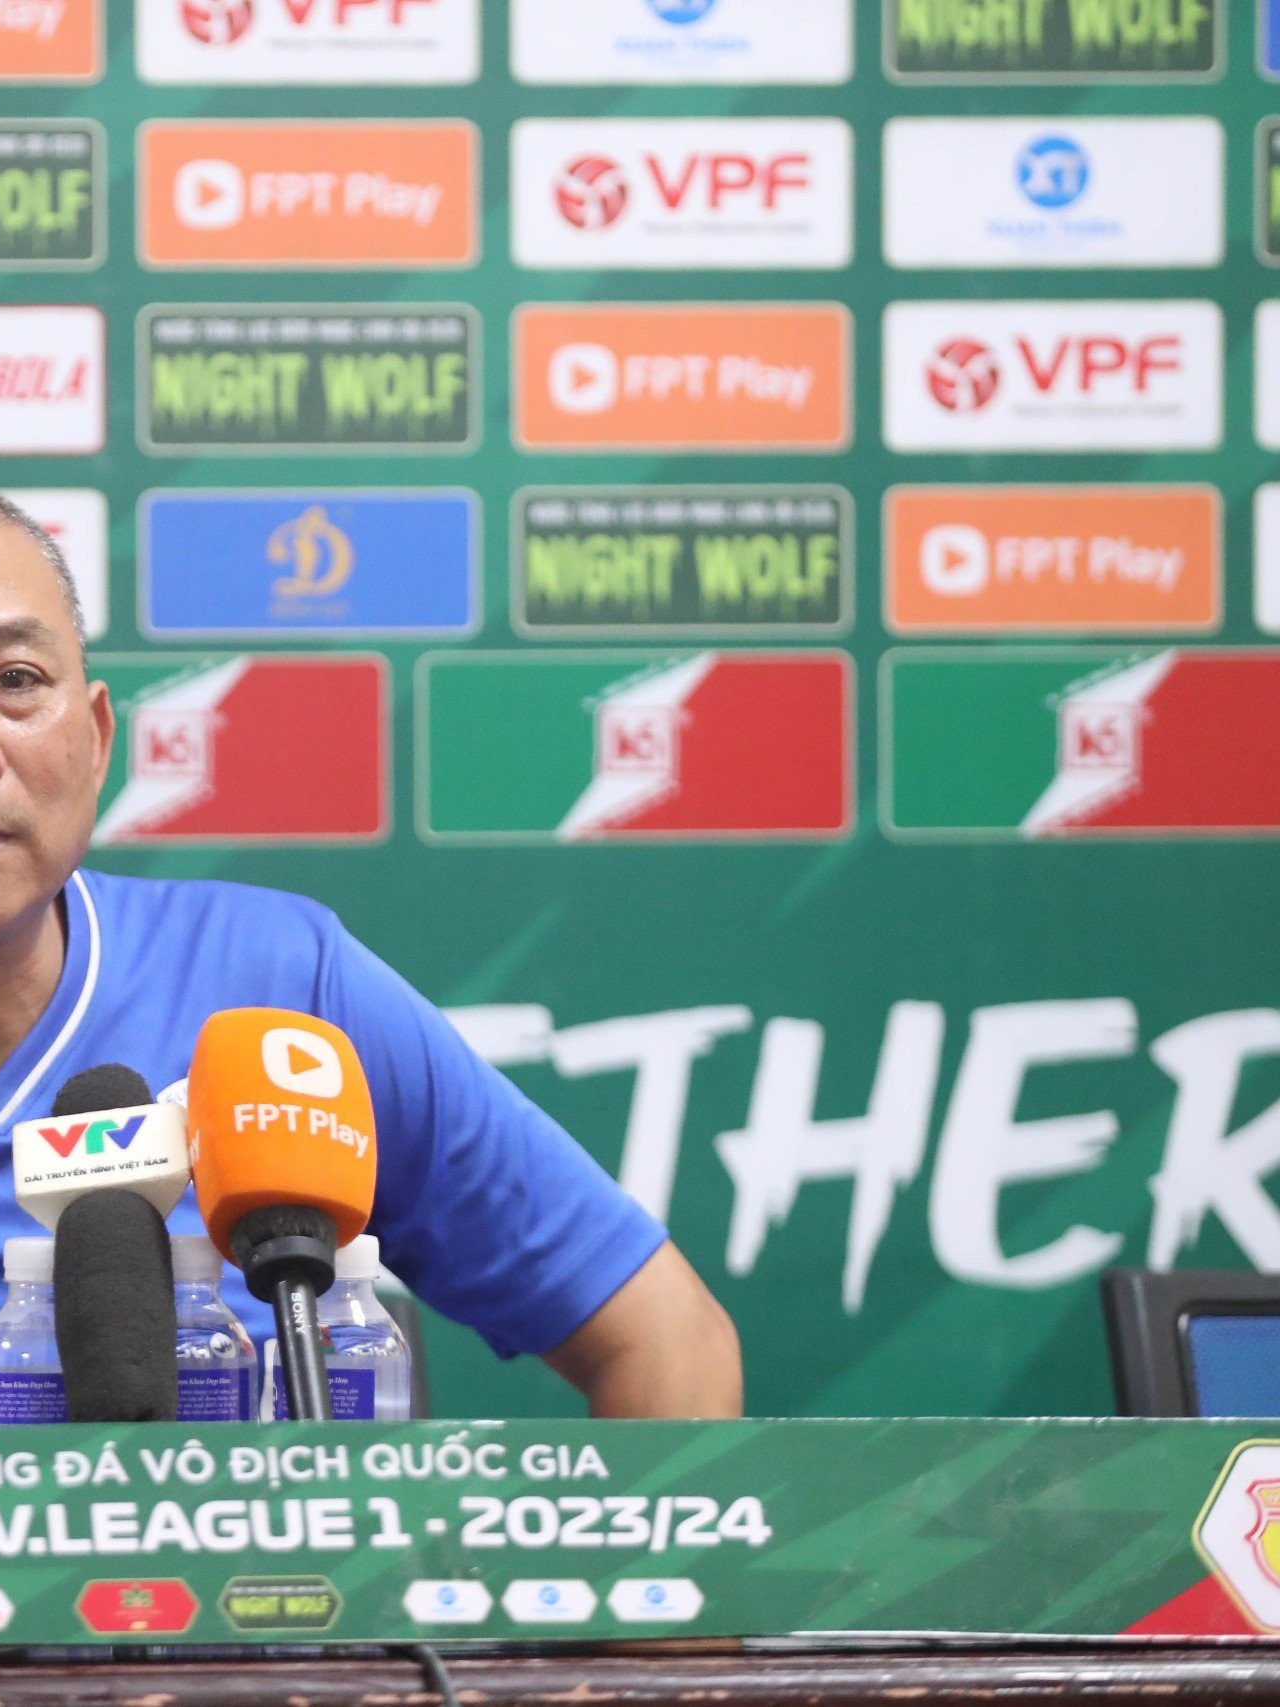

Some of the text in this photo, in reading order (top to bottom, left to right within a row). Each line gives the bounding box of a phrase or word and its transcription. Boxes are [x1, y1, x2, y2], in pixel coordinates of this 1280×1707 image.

[248, 172, 443, 227] FPT Play
[644, 151, 812, 211] VPF
[152, 351, 465, 432] NIGHT WOLF
[623, 355, 814, 410] FPT Play
[1013, 334, 1183, 393] VPF
[527, 532, 839, 617] NIGHT WOLF
[994, 536, 1184, 592] FPT Play
[38, 1114, 148, 1158] VTV
[233, 1103, 370, 1159] FPT Play
[442, 997, 1280, 1315] THER
[291, 1292, 310, 1334] SONY
[53, 1439, 129, 1487] ĐÁ
[140, 1438, 216, 1485] VÔ
[229, 1444, 350, 1489] ĐỊCH
[362, 1430, 508, 1481] QUỐC
[521, 1444, 610, 1480] GIA
[368, 1496, 411, 1547] 1
[459, 1495, 774, 1553] 2023/24
